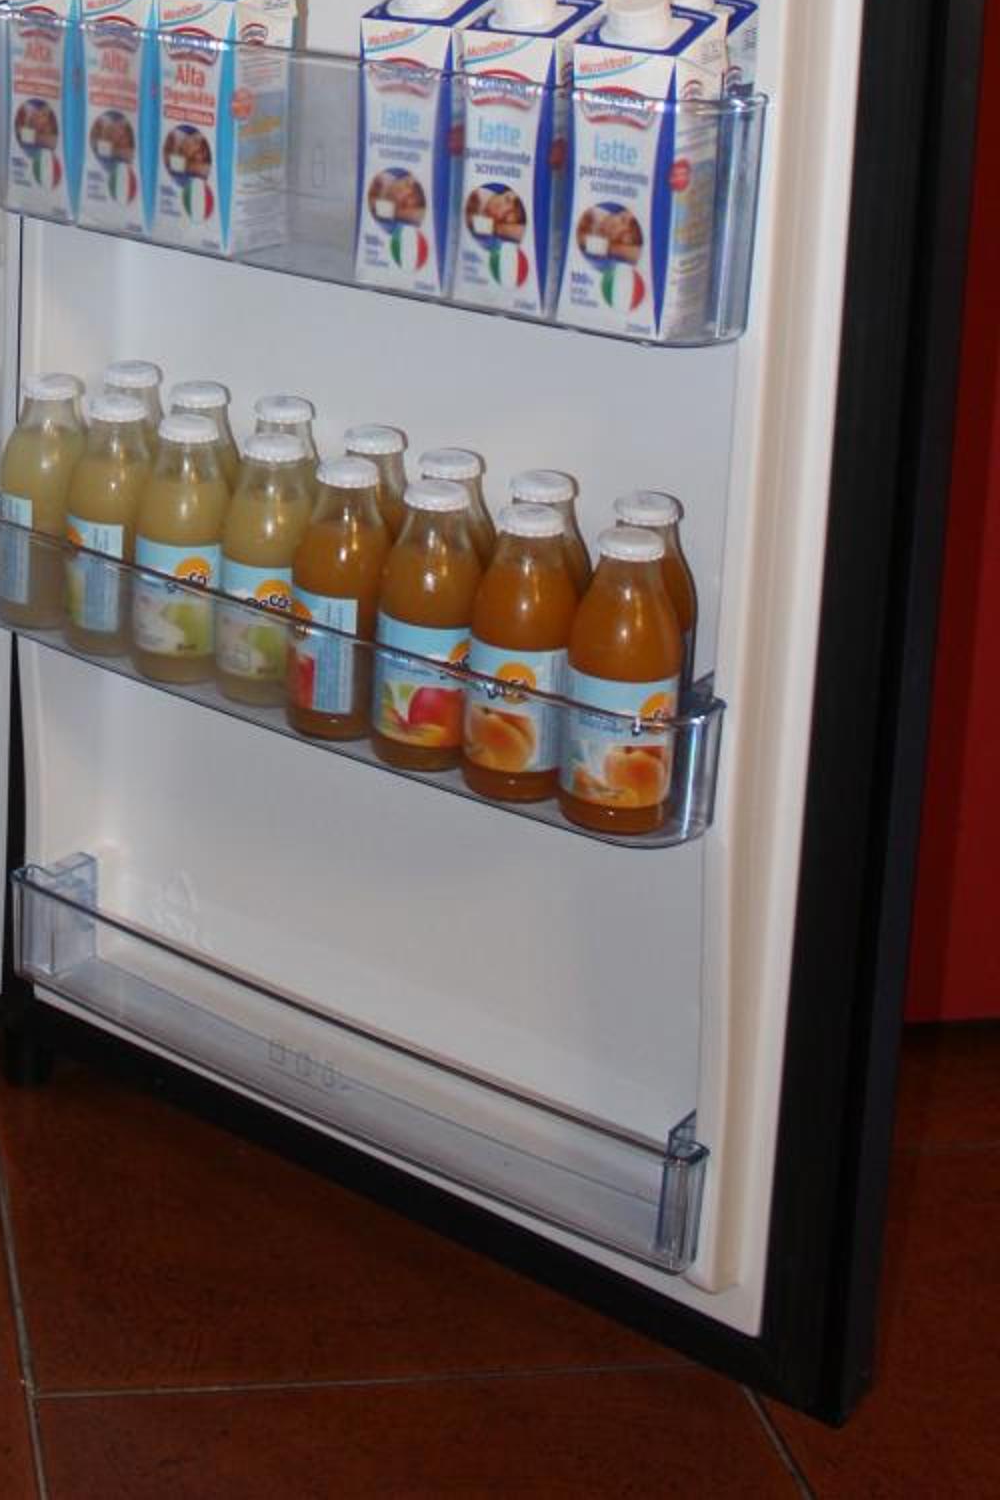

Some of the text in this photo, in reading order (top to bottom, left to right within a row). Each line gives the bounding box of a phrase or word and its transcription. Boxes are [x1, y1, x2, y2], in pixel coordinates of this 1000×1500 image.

[175, 63, 205, 87] Alta
[381, 104, 420, 132] latte
[478, 117, 521, 146] latte
[594, 134, 638, 165] latte
